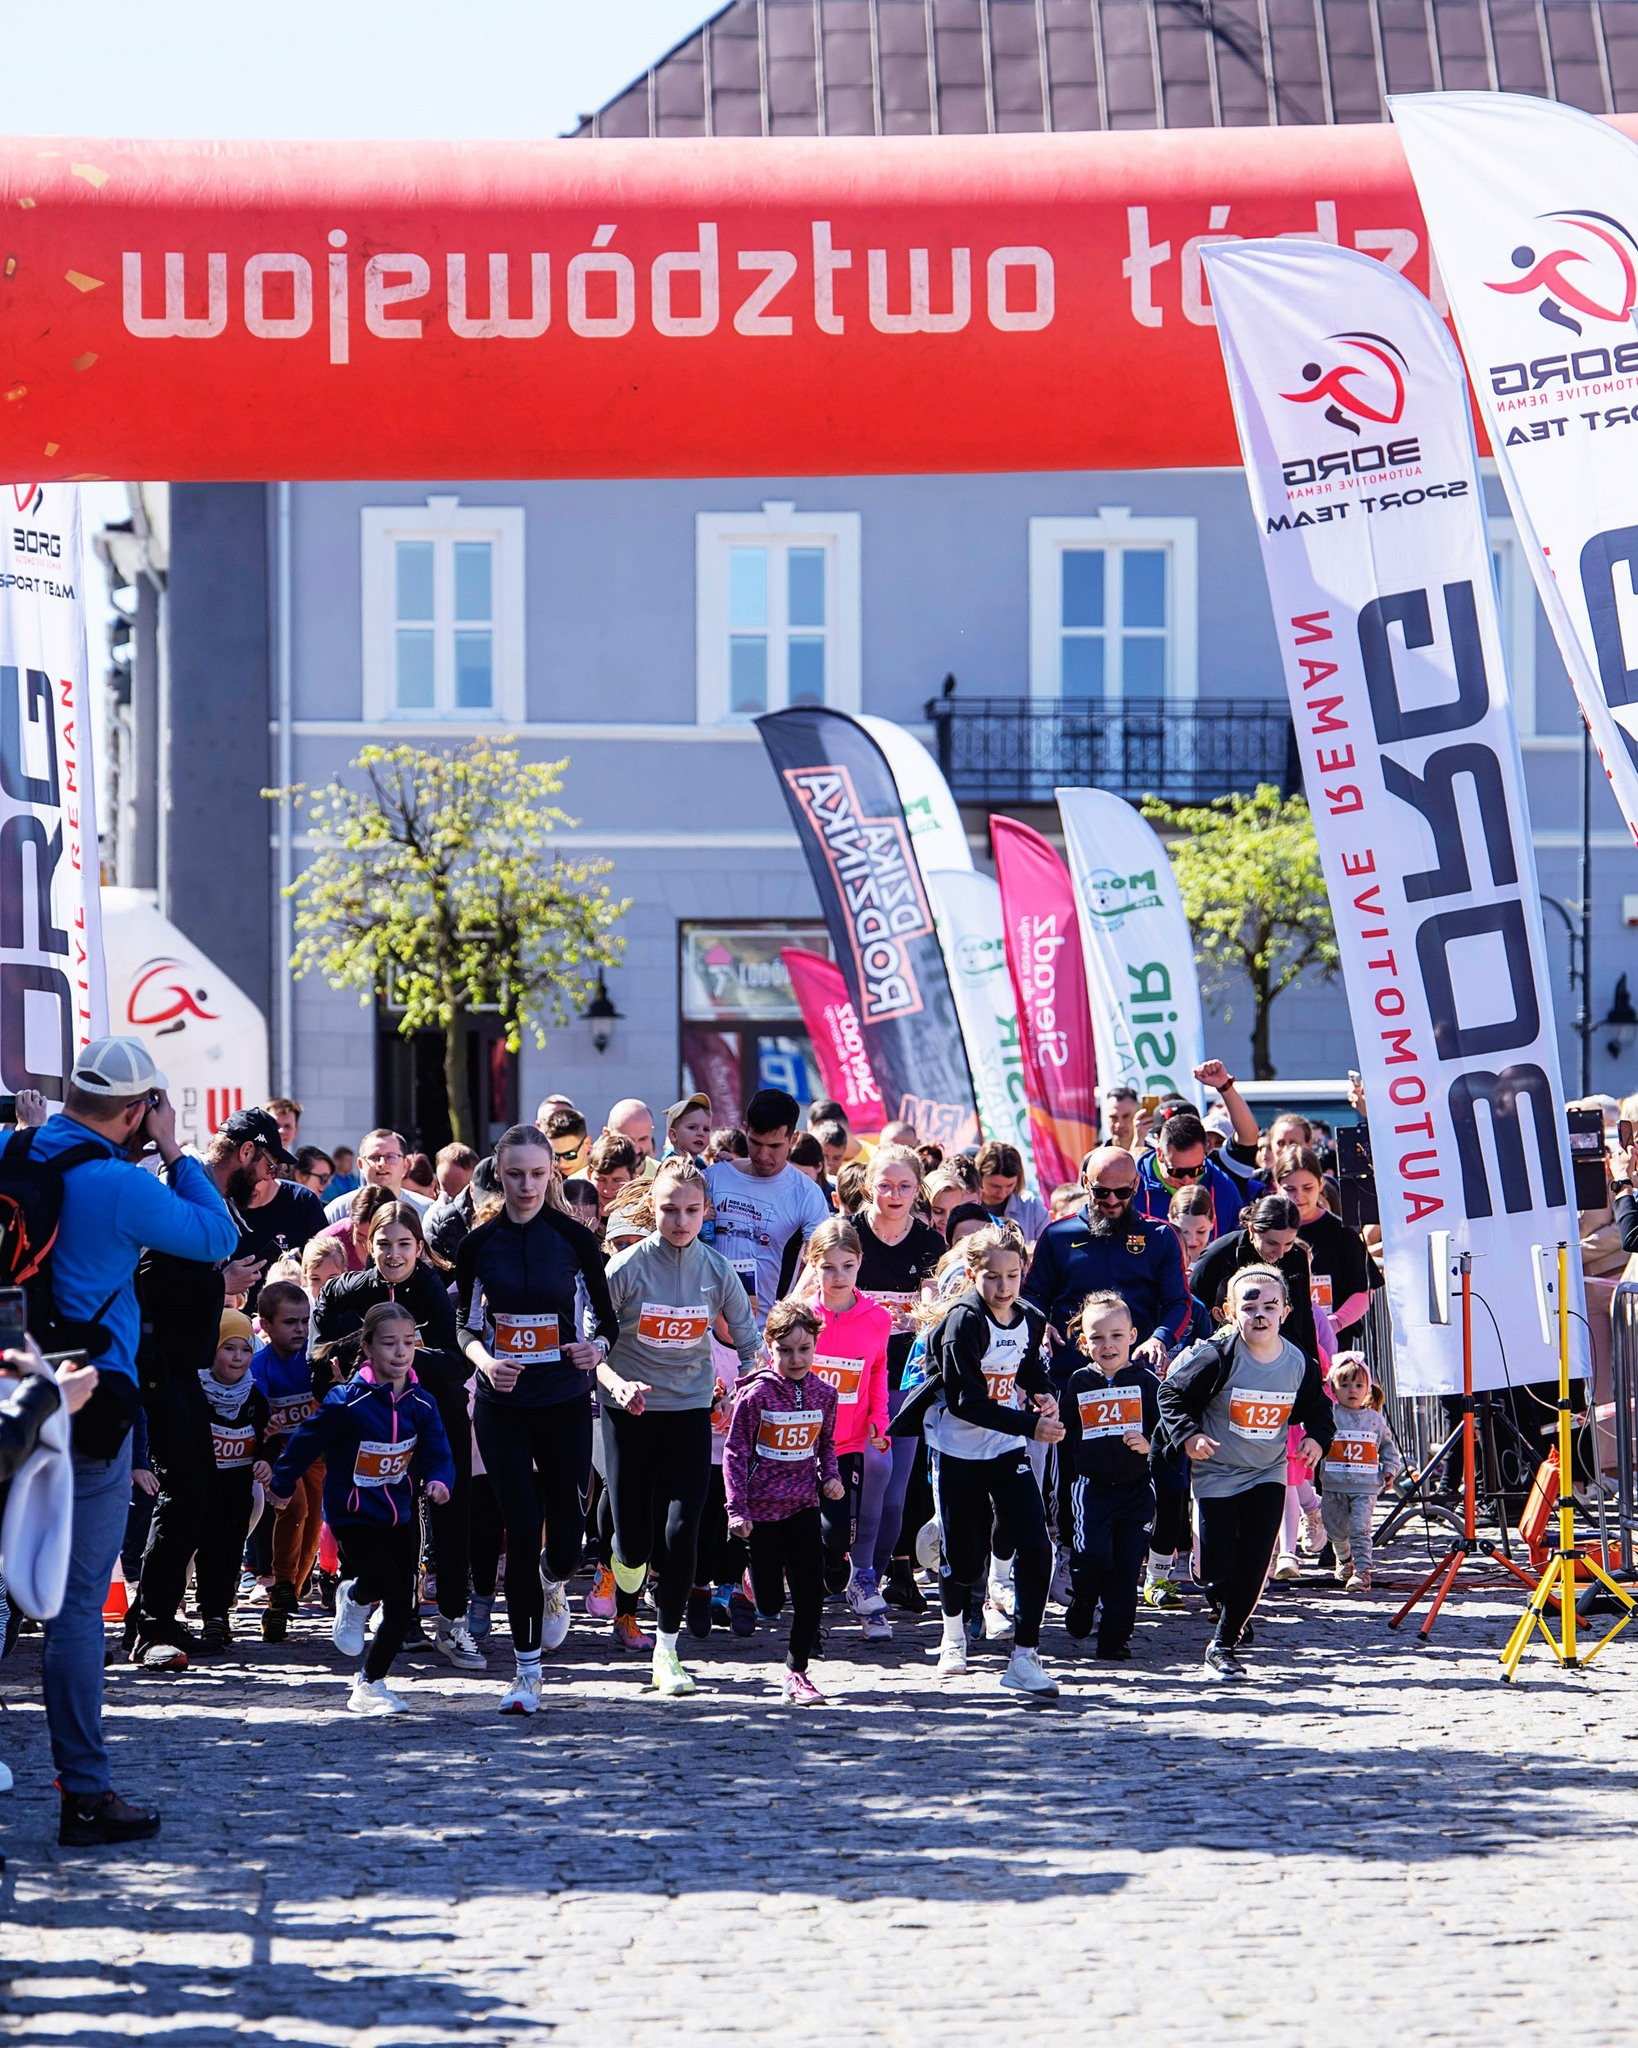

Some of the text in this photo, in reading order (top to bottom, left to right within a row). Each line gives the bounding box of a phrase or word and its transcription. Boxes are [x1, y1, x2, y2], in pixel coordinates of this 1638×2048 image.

[121, 221, 1055, 364] województwo
[13, 528, 60, 557] BORG
[43, 581, 75, 599] TEAM
[60, 679, 82, 870] REMAN
[0, 666, 74, 1103] ORG
[656, 1320, 693, 1337] 162
[510, 1330, 537, 1349] 49
[987, 1377, 1015, 1397] 189
[1097, 1402, 1122, 1423] 24
[1246, 1406, 1281, 1425] 132
[775, 1427, 809, 1447] 155
[213, 1439, 245, 1457] 200
[1343, 1443, 1363, 1460] 42
[379, 1455, 403, 1475] 95
